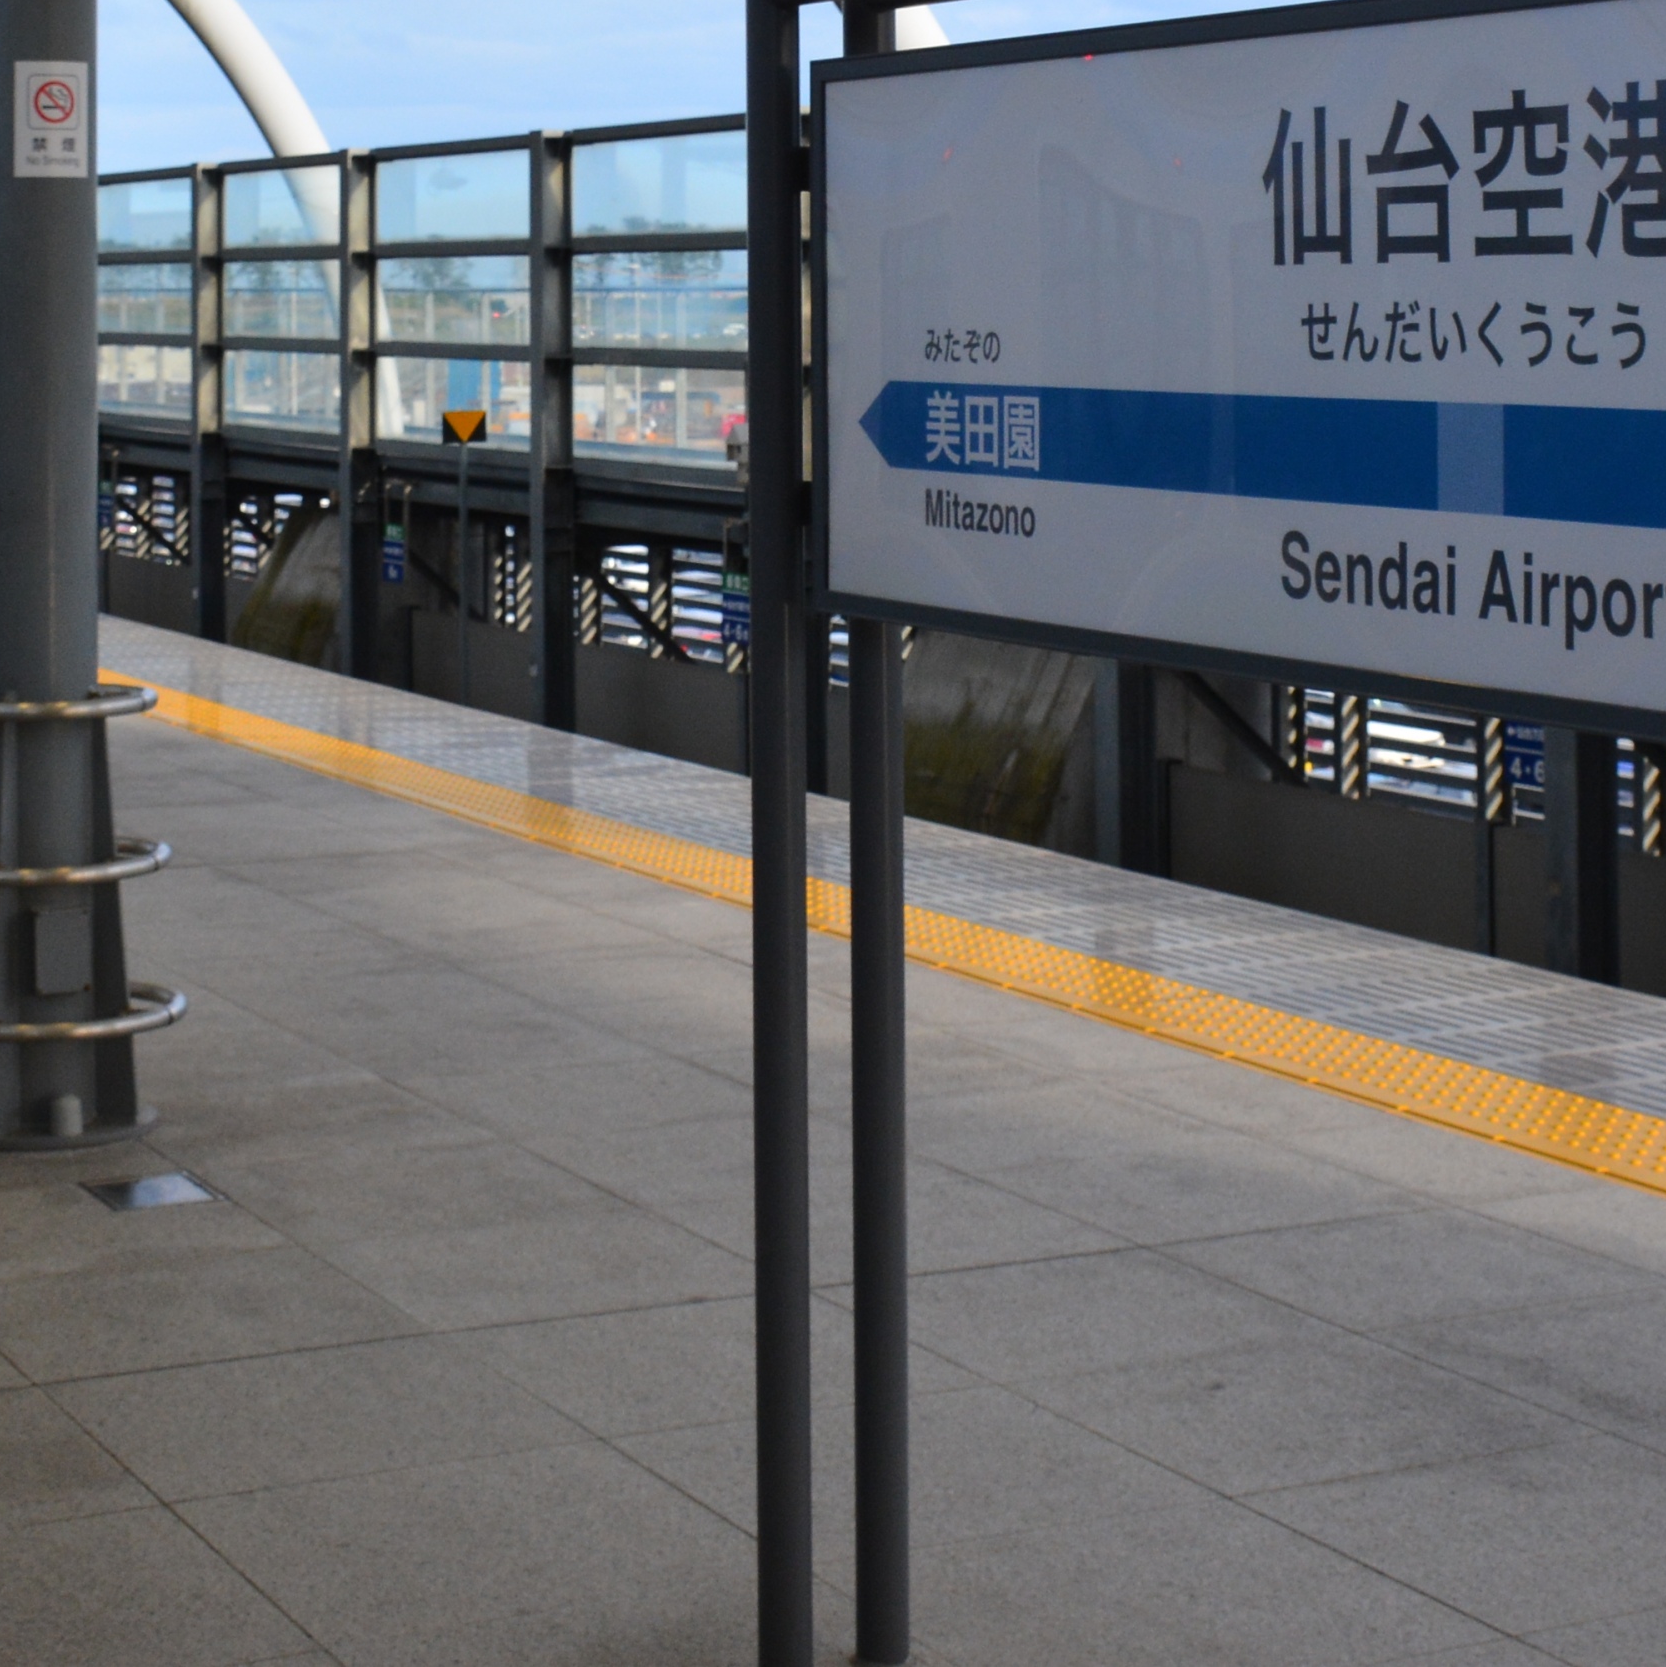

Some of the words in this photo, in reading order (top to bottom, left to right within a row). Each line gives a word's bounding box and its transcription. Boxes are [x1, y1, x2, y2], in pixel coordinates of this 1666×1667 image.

[924, 328, 1002, 365] みたぞの
[1300, 300, 1647, 370] せんだいくうこう
[925, 389, 1041, 473] 美田園
[924, 487, 1037, 539] Mitazono
[1280, 529, 1457, 617] Sendai
